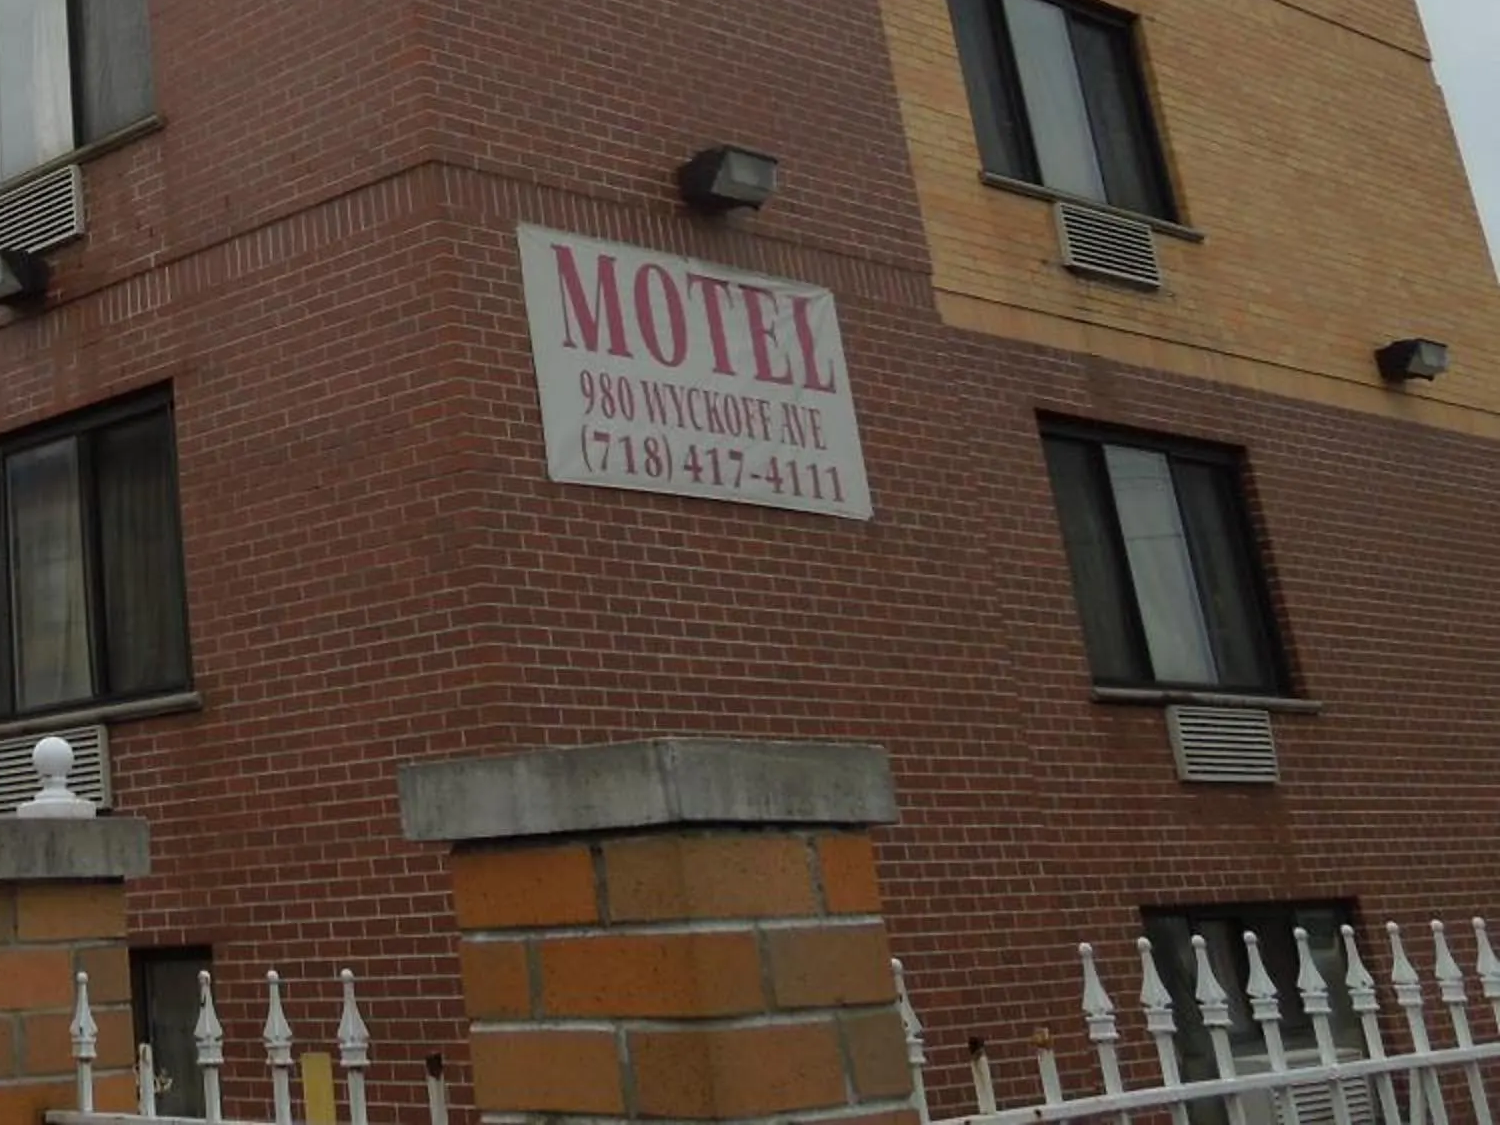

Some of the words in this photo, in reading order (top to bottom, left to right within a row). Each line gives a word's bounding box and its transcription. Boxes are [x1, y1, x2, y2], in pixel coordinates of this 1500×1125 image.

[550, 243, 838, 394] MOTEL
[579, 369, 636, 421] 980
[640, 379, 772, 442] WYCKOFF
[780, 402, 828, 451] AVE
[581, 424, 673, 482] (718)
[683, 444, 846, 503] 417-4111
